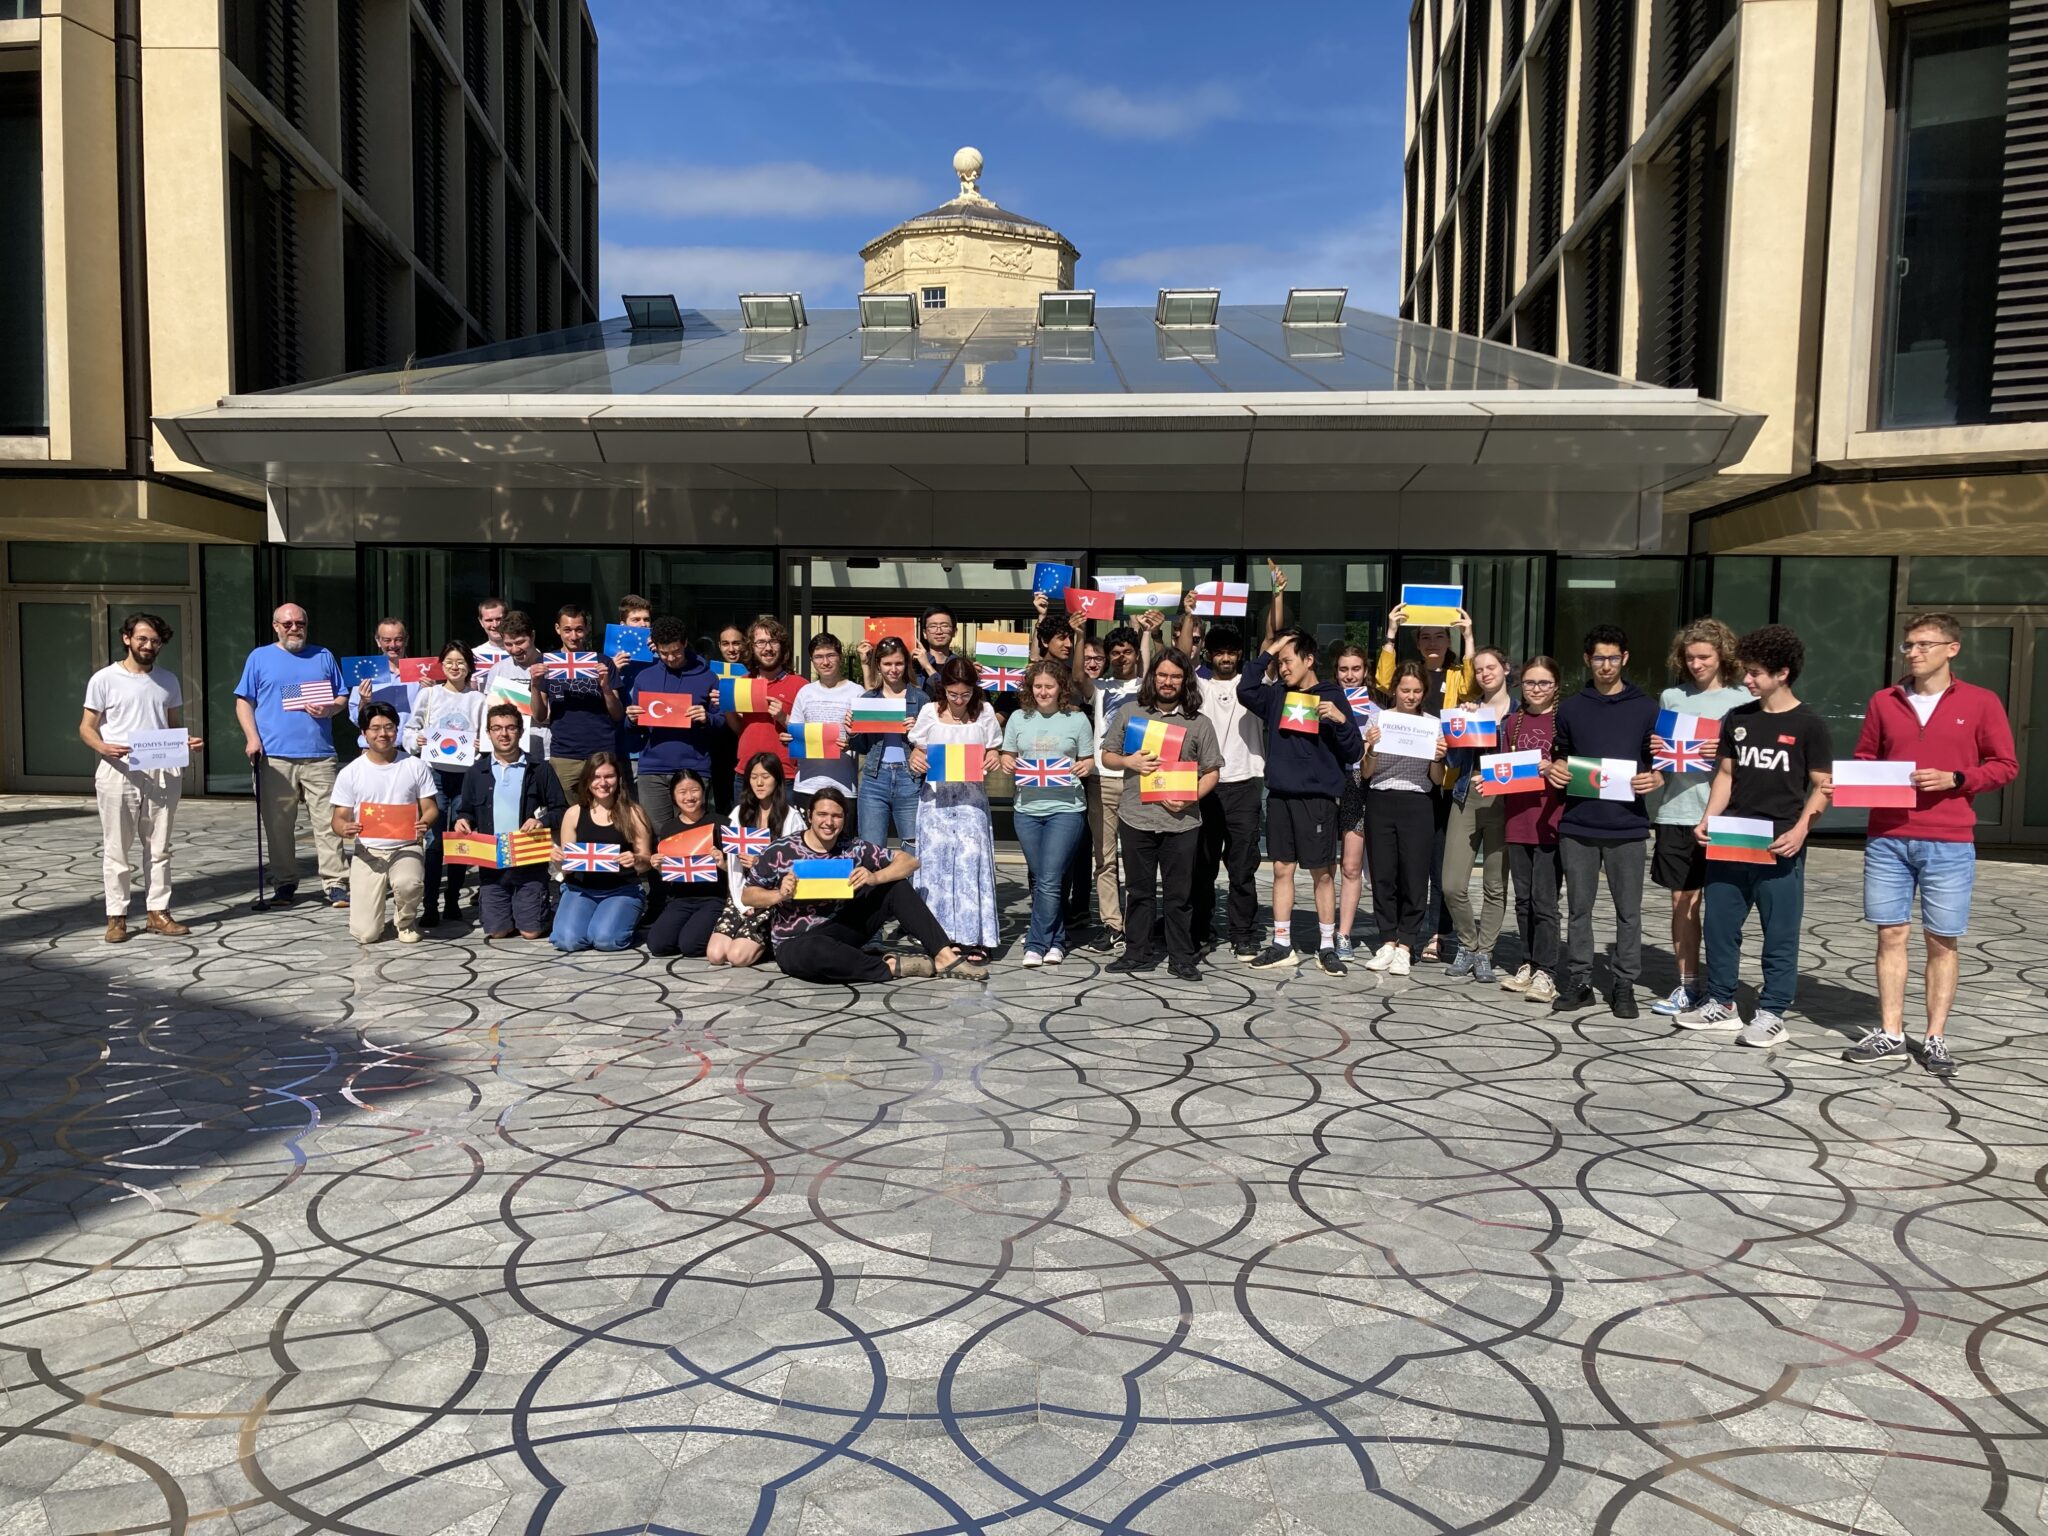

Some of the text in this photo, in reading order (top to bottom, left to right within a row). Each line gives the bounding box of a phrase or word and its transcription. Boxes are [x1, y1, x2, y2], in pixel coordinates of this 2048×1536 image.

[1382, 723, 1411, 731] PROMYS
[1412, 727, 1434, 736] Europe
[133, 741, 162, 749] PROMYS
[163, 740, 184, 750] Europe
[1735, 744, 1790, 772] NASA
